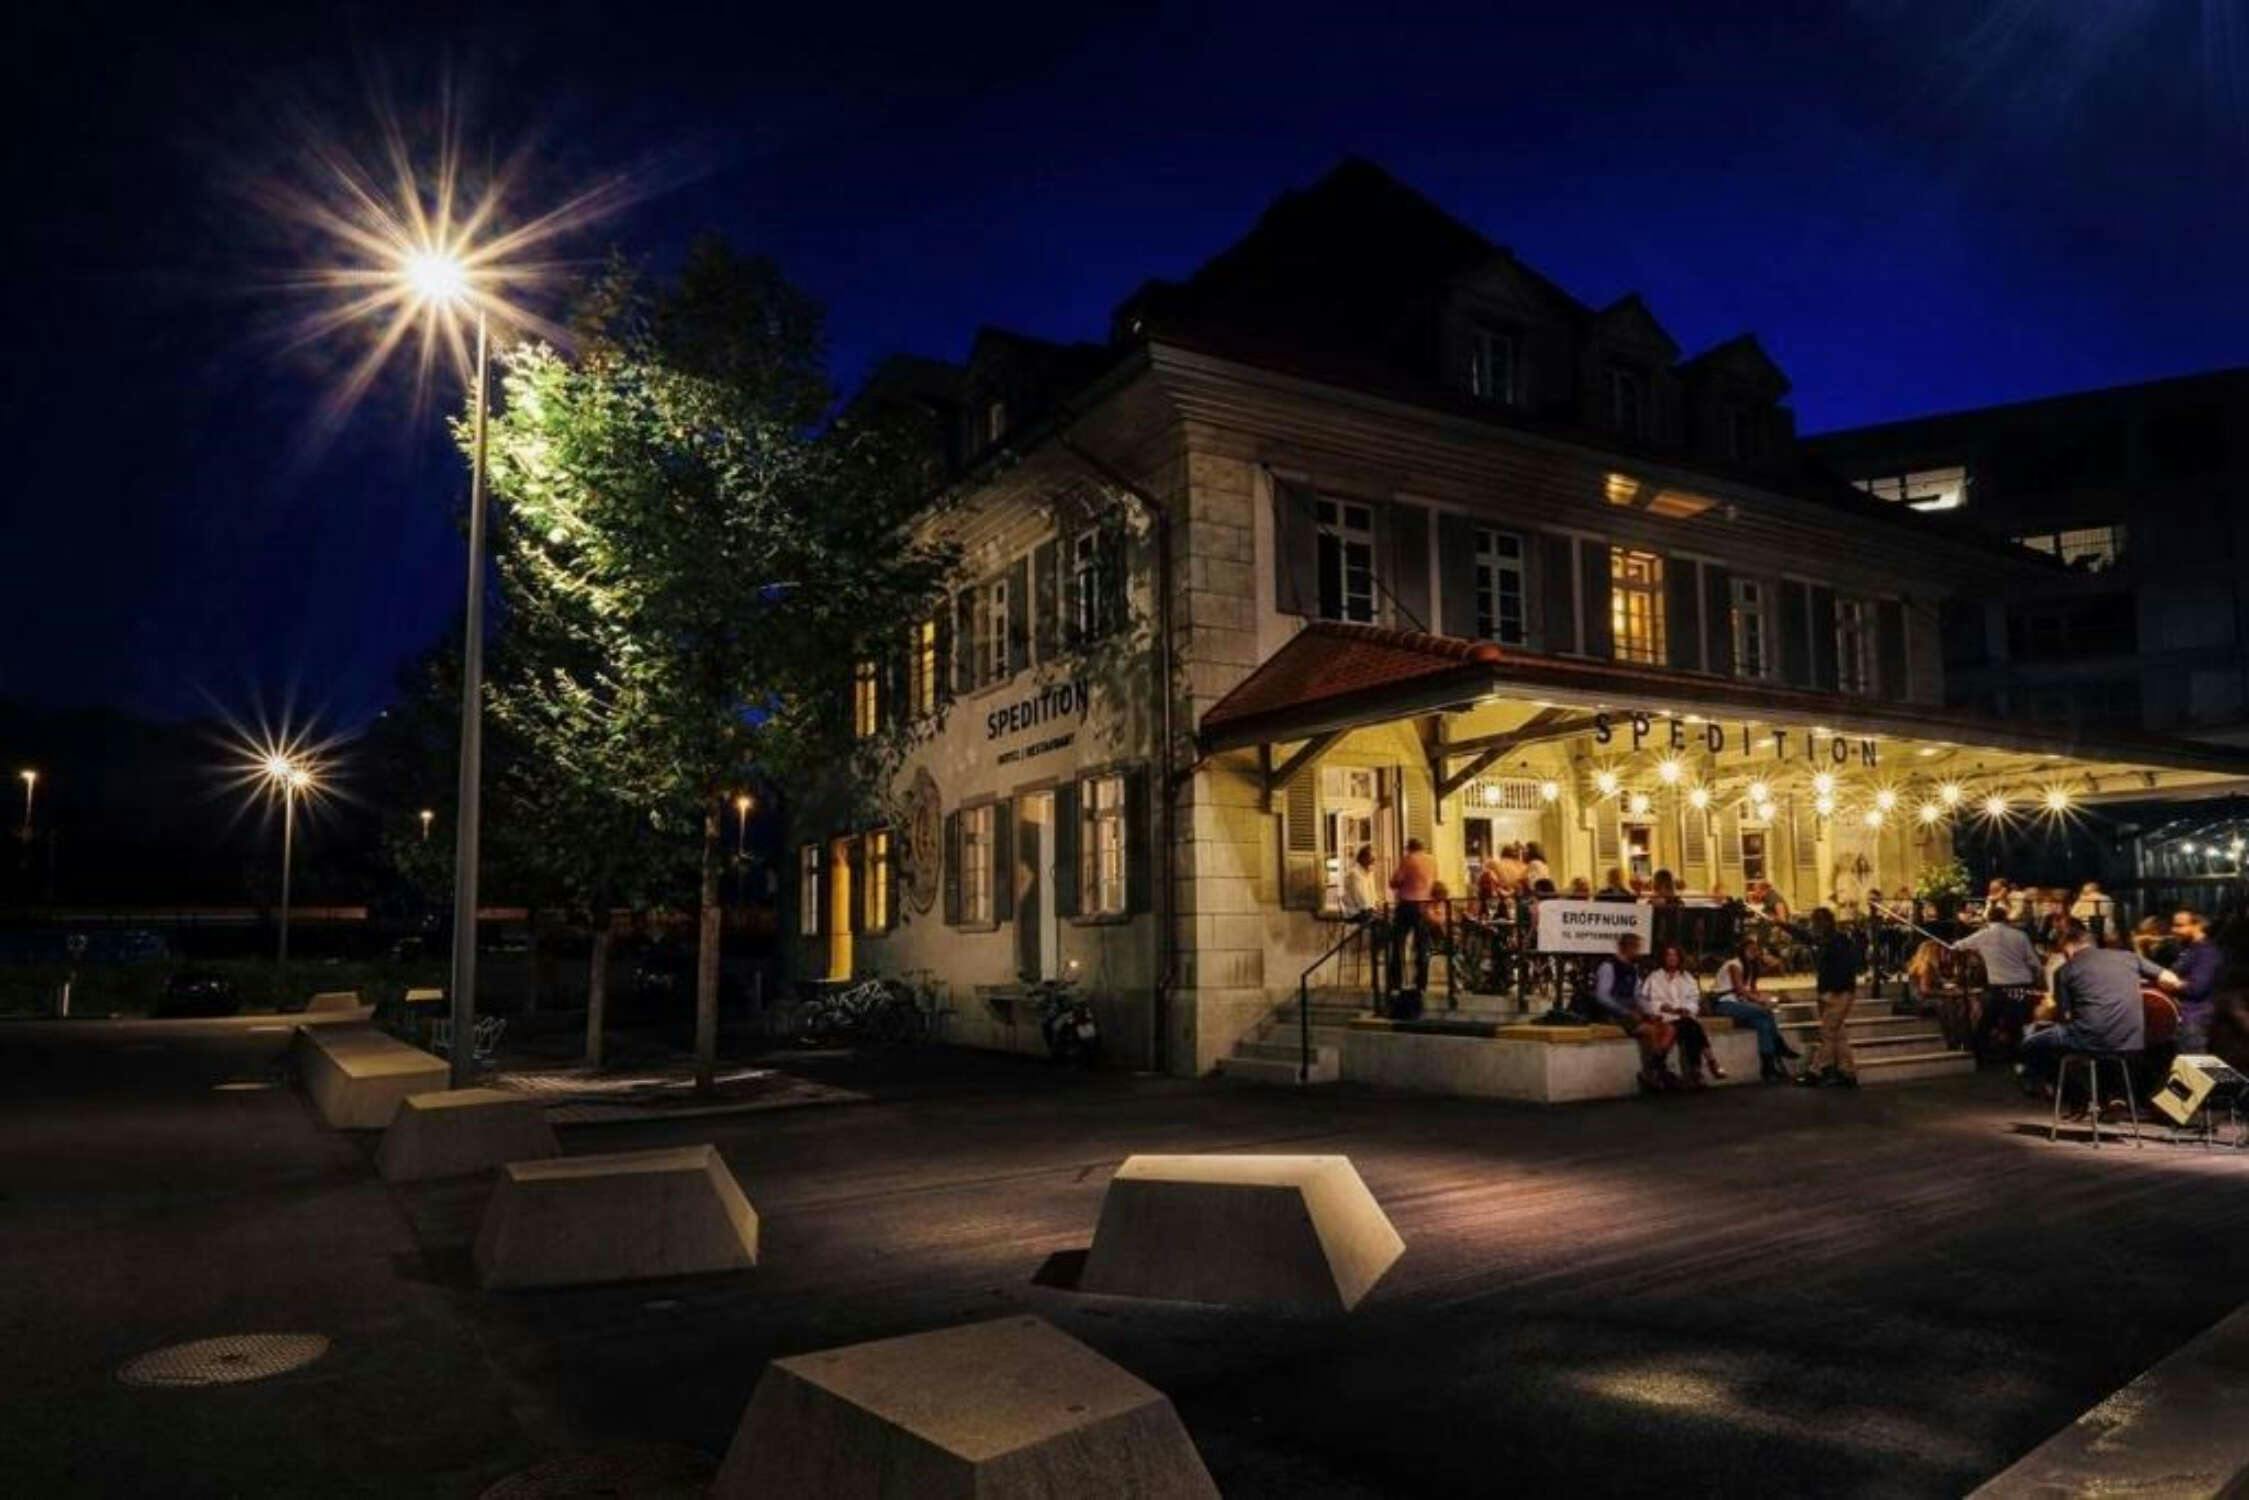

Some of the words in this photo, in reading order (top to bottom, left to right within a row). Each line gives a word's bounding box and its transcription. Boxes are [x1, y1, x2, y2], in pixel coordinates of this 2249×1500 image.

[987, 679, 1089, 740] SPEDITION
[1595, 711, 1877, 767] SPEDITION
[1563, 911, 1638, 926] ERÖFFNUNG
